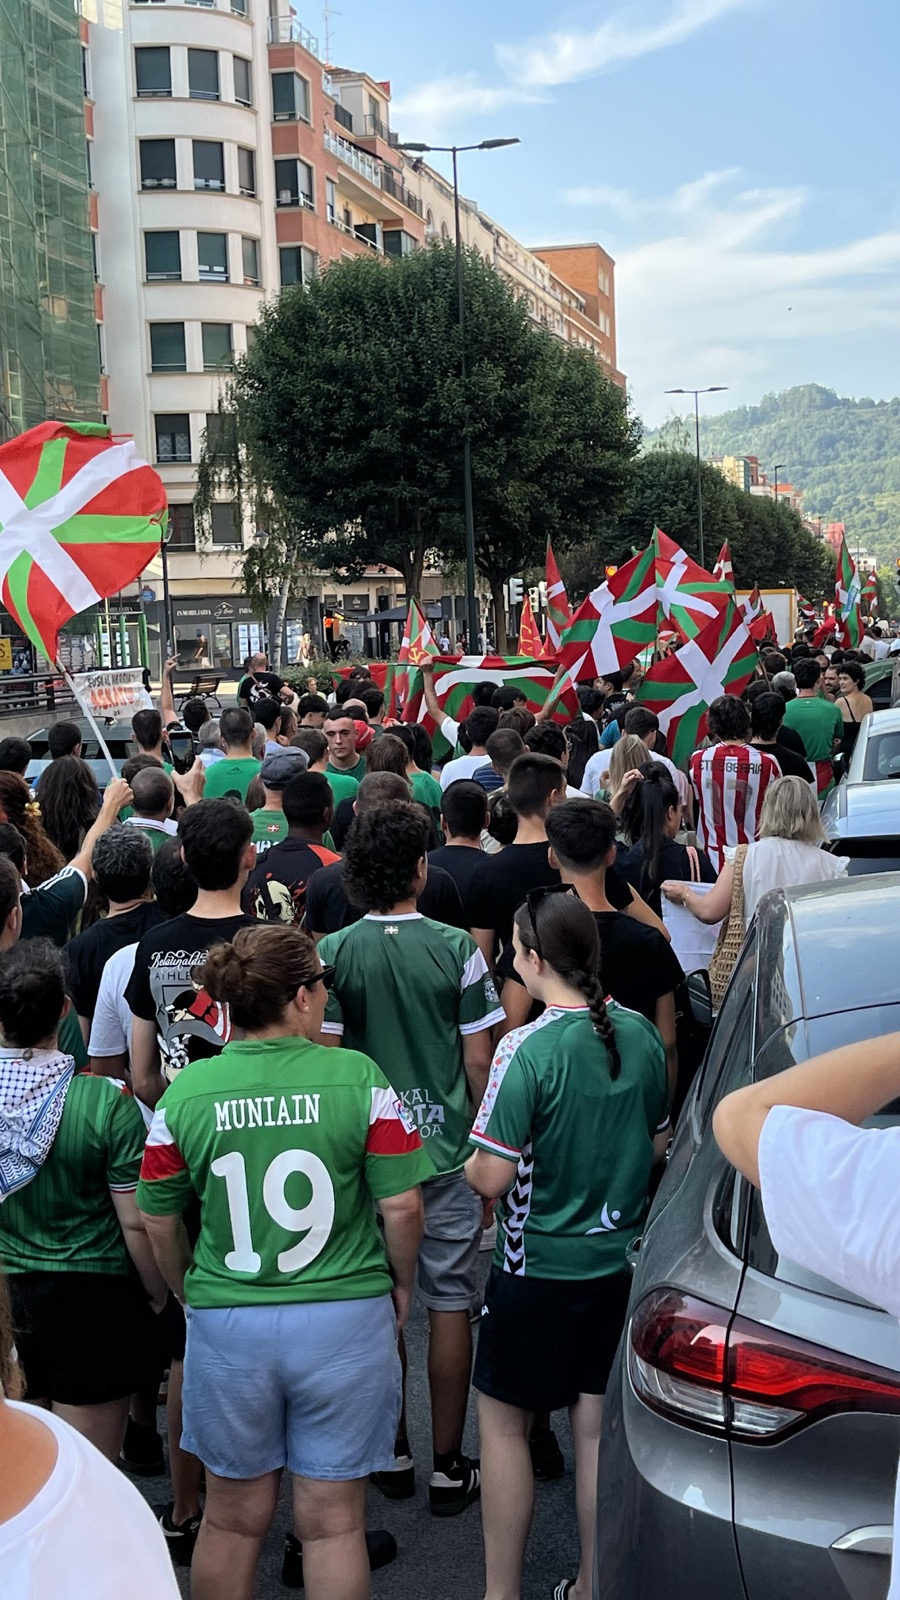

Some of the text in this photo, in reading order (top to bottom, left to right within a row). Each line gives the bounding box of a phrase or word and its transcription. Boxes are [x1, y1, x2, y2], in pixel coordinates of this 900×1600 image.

[154, 971, 191, 981] ATHLE
[400, 1088, 434, 1107] KAL
[214, 1093, 321, 1132] MUNIAIN
[211, 1149, 335, 1274] 19
